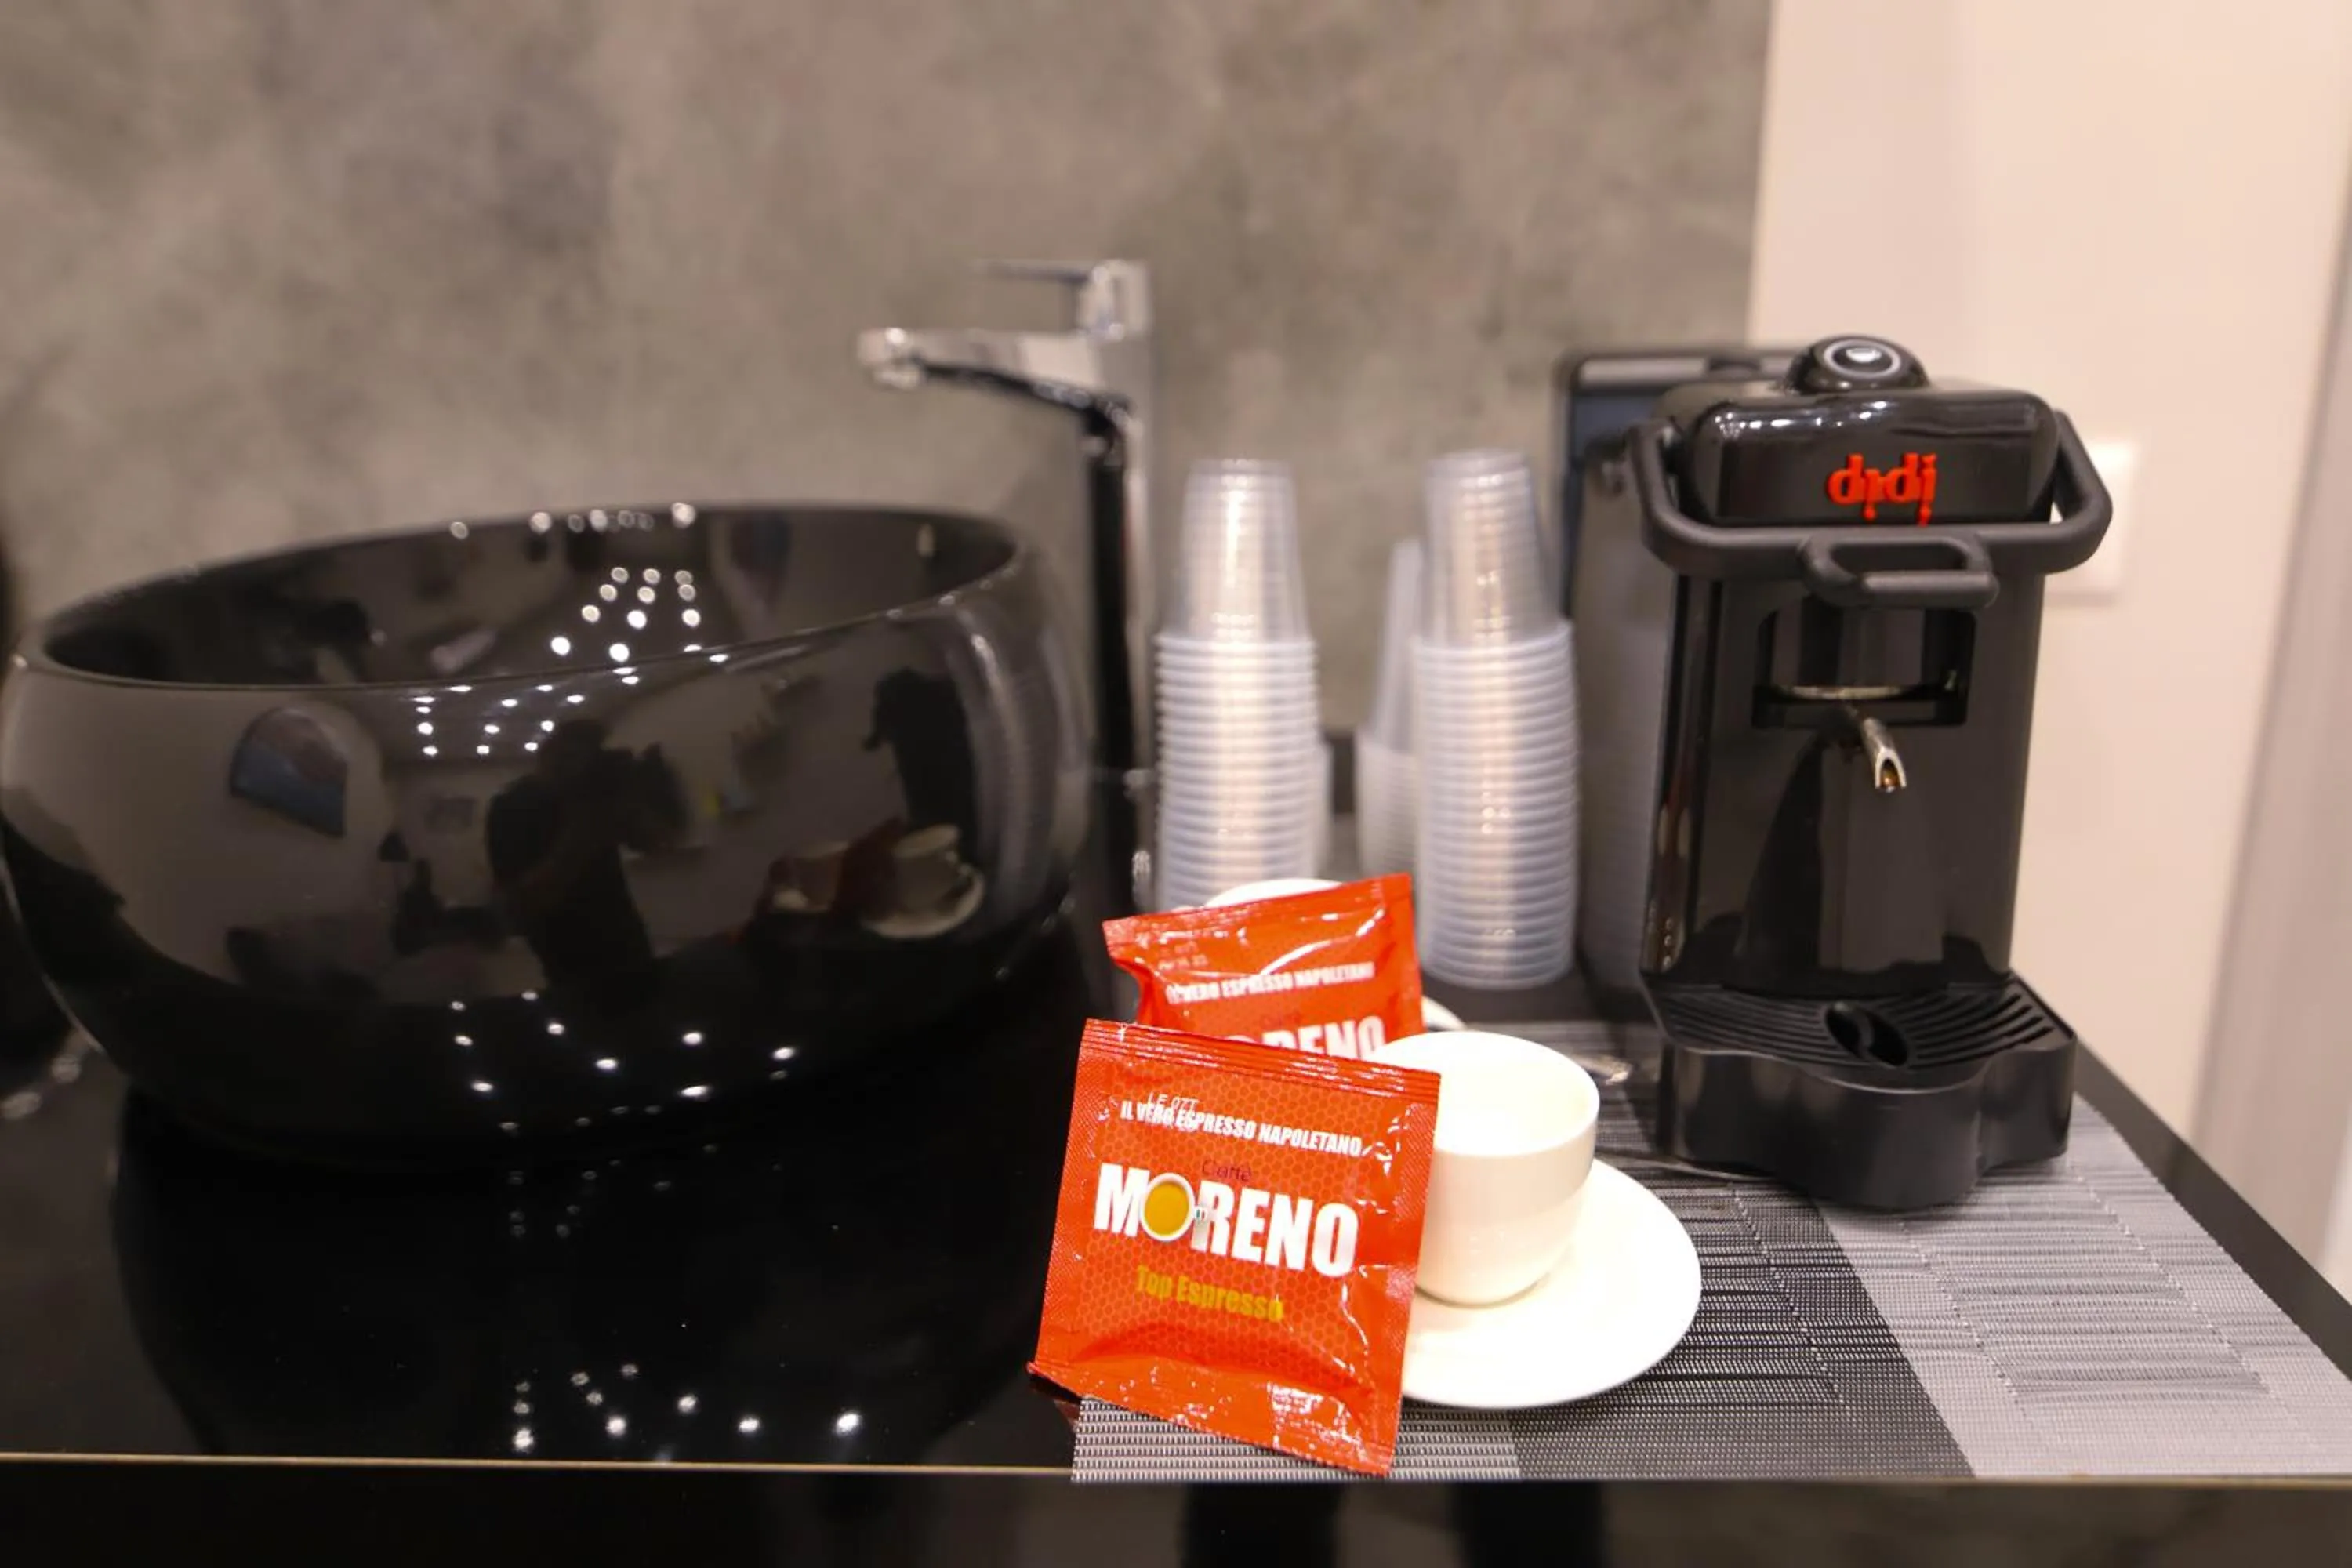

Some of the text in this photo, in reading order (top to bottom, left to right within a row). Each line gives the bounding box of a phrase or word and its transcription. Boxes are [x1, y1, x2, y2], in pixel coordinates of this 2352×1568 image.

[1120, 1100, 1363, 1156] IL VERO ESPRESSO NAPOLETANO
[1094, 1163, 1359, 1277] MORENO
[1137, 1265, 1283, 1323] Top Espresso
